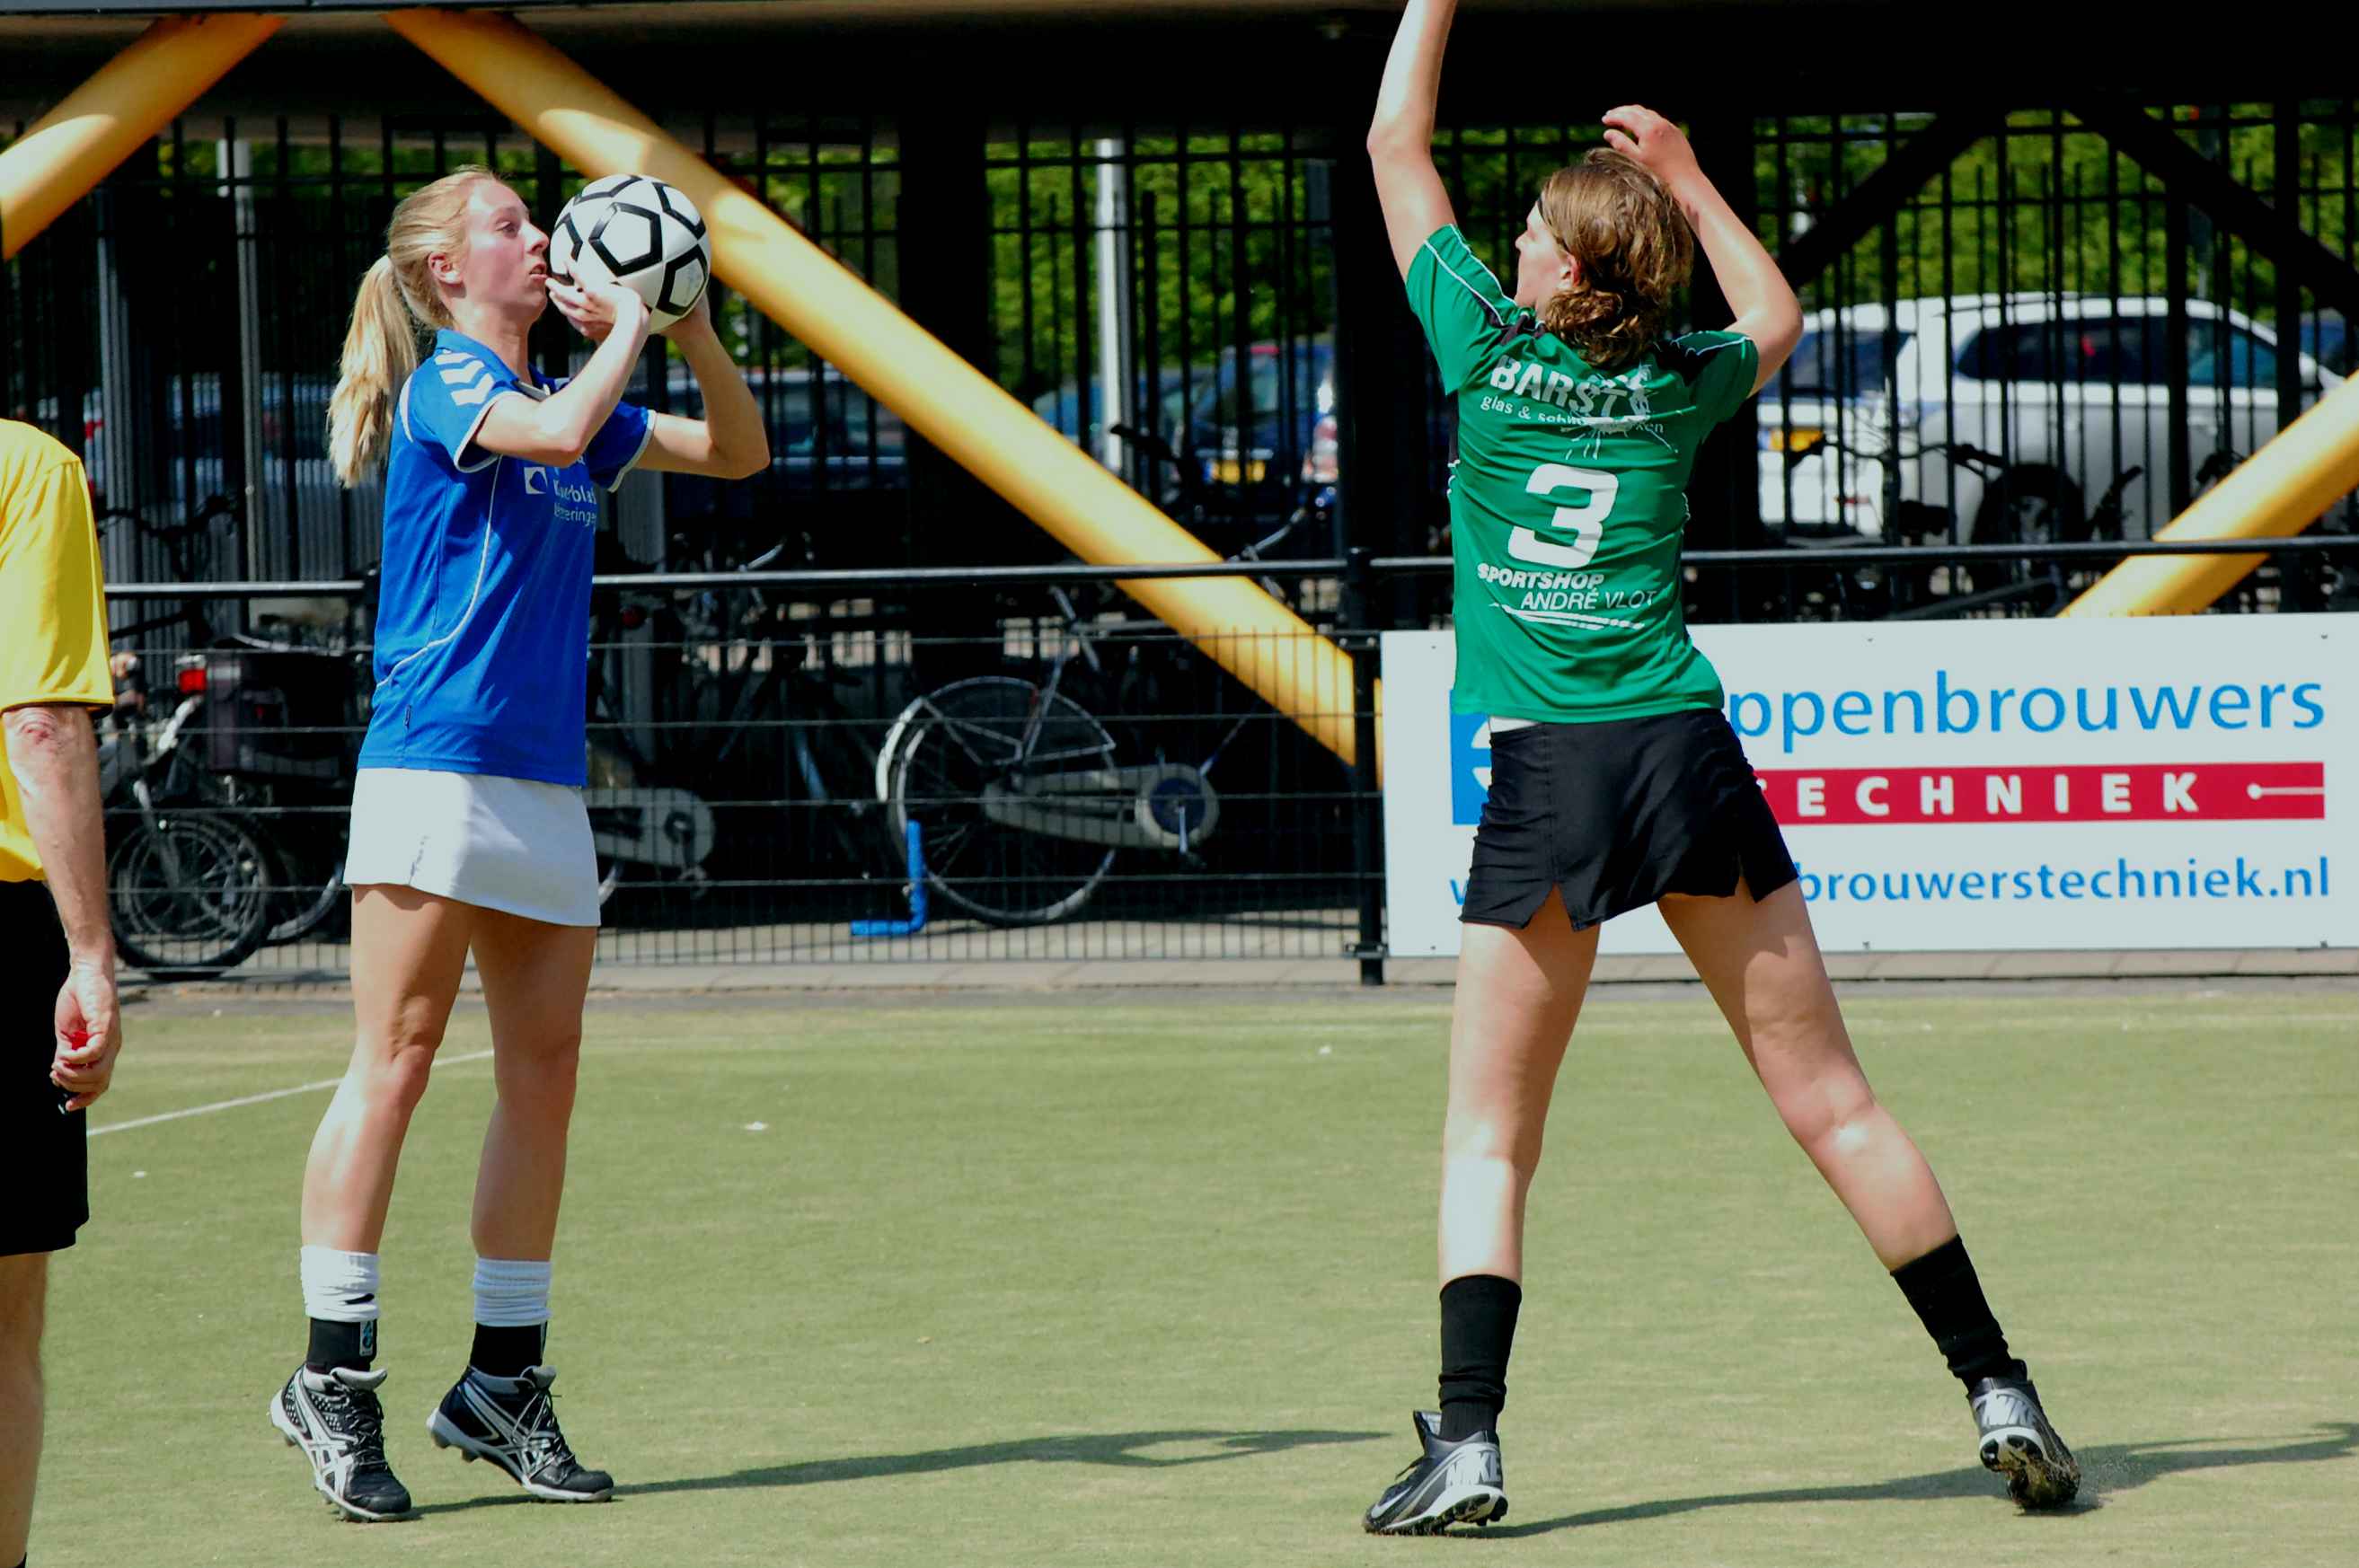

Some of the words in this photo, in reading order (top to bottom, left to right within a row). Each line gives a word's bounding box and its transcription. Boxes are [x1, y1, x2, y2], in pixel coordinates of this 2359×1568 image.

[1480, 395, 1513, 415] glas
[1518, 405, 1532, 420] &
[1507, 462, 1619, 569] 3
[1477, 562, 1604, 590] SPORTSHOP
[1520, 587, 1600, 610] ANDRÉ
[1605, 590, 1657, 608] VLOT
[1729, 670, 2325, 753] ppenbrouwers
[1756, 771, 2200, 817] ECHNIEK
[1795, 856, 2329, 902] brouwerstechniek.nl
